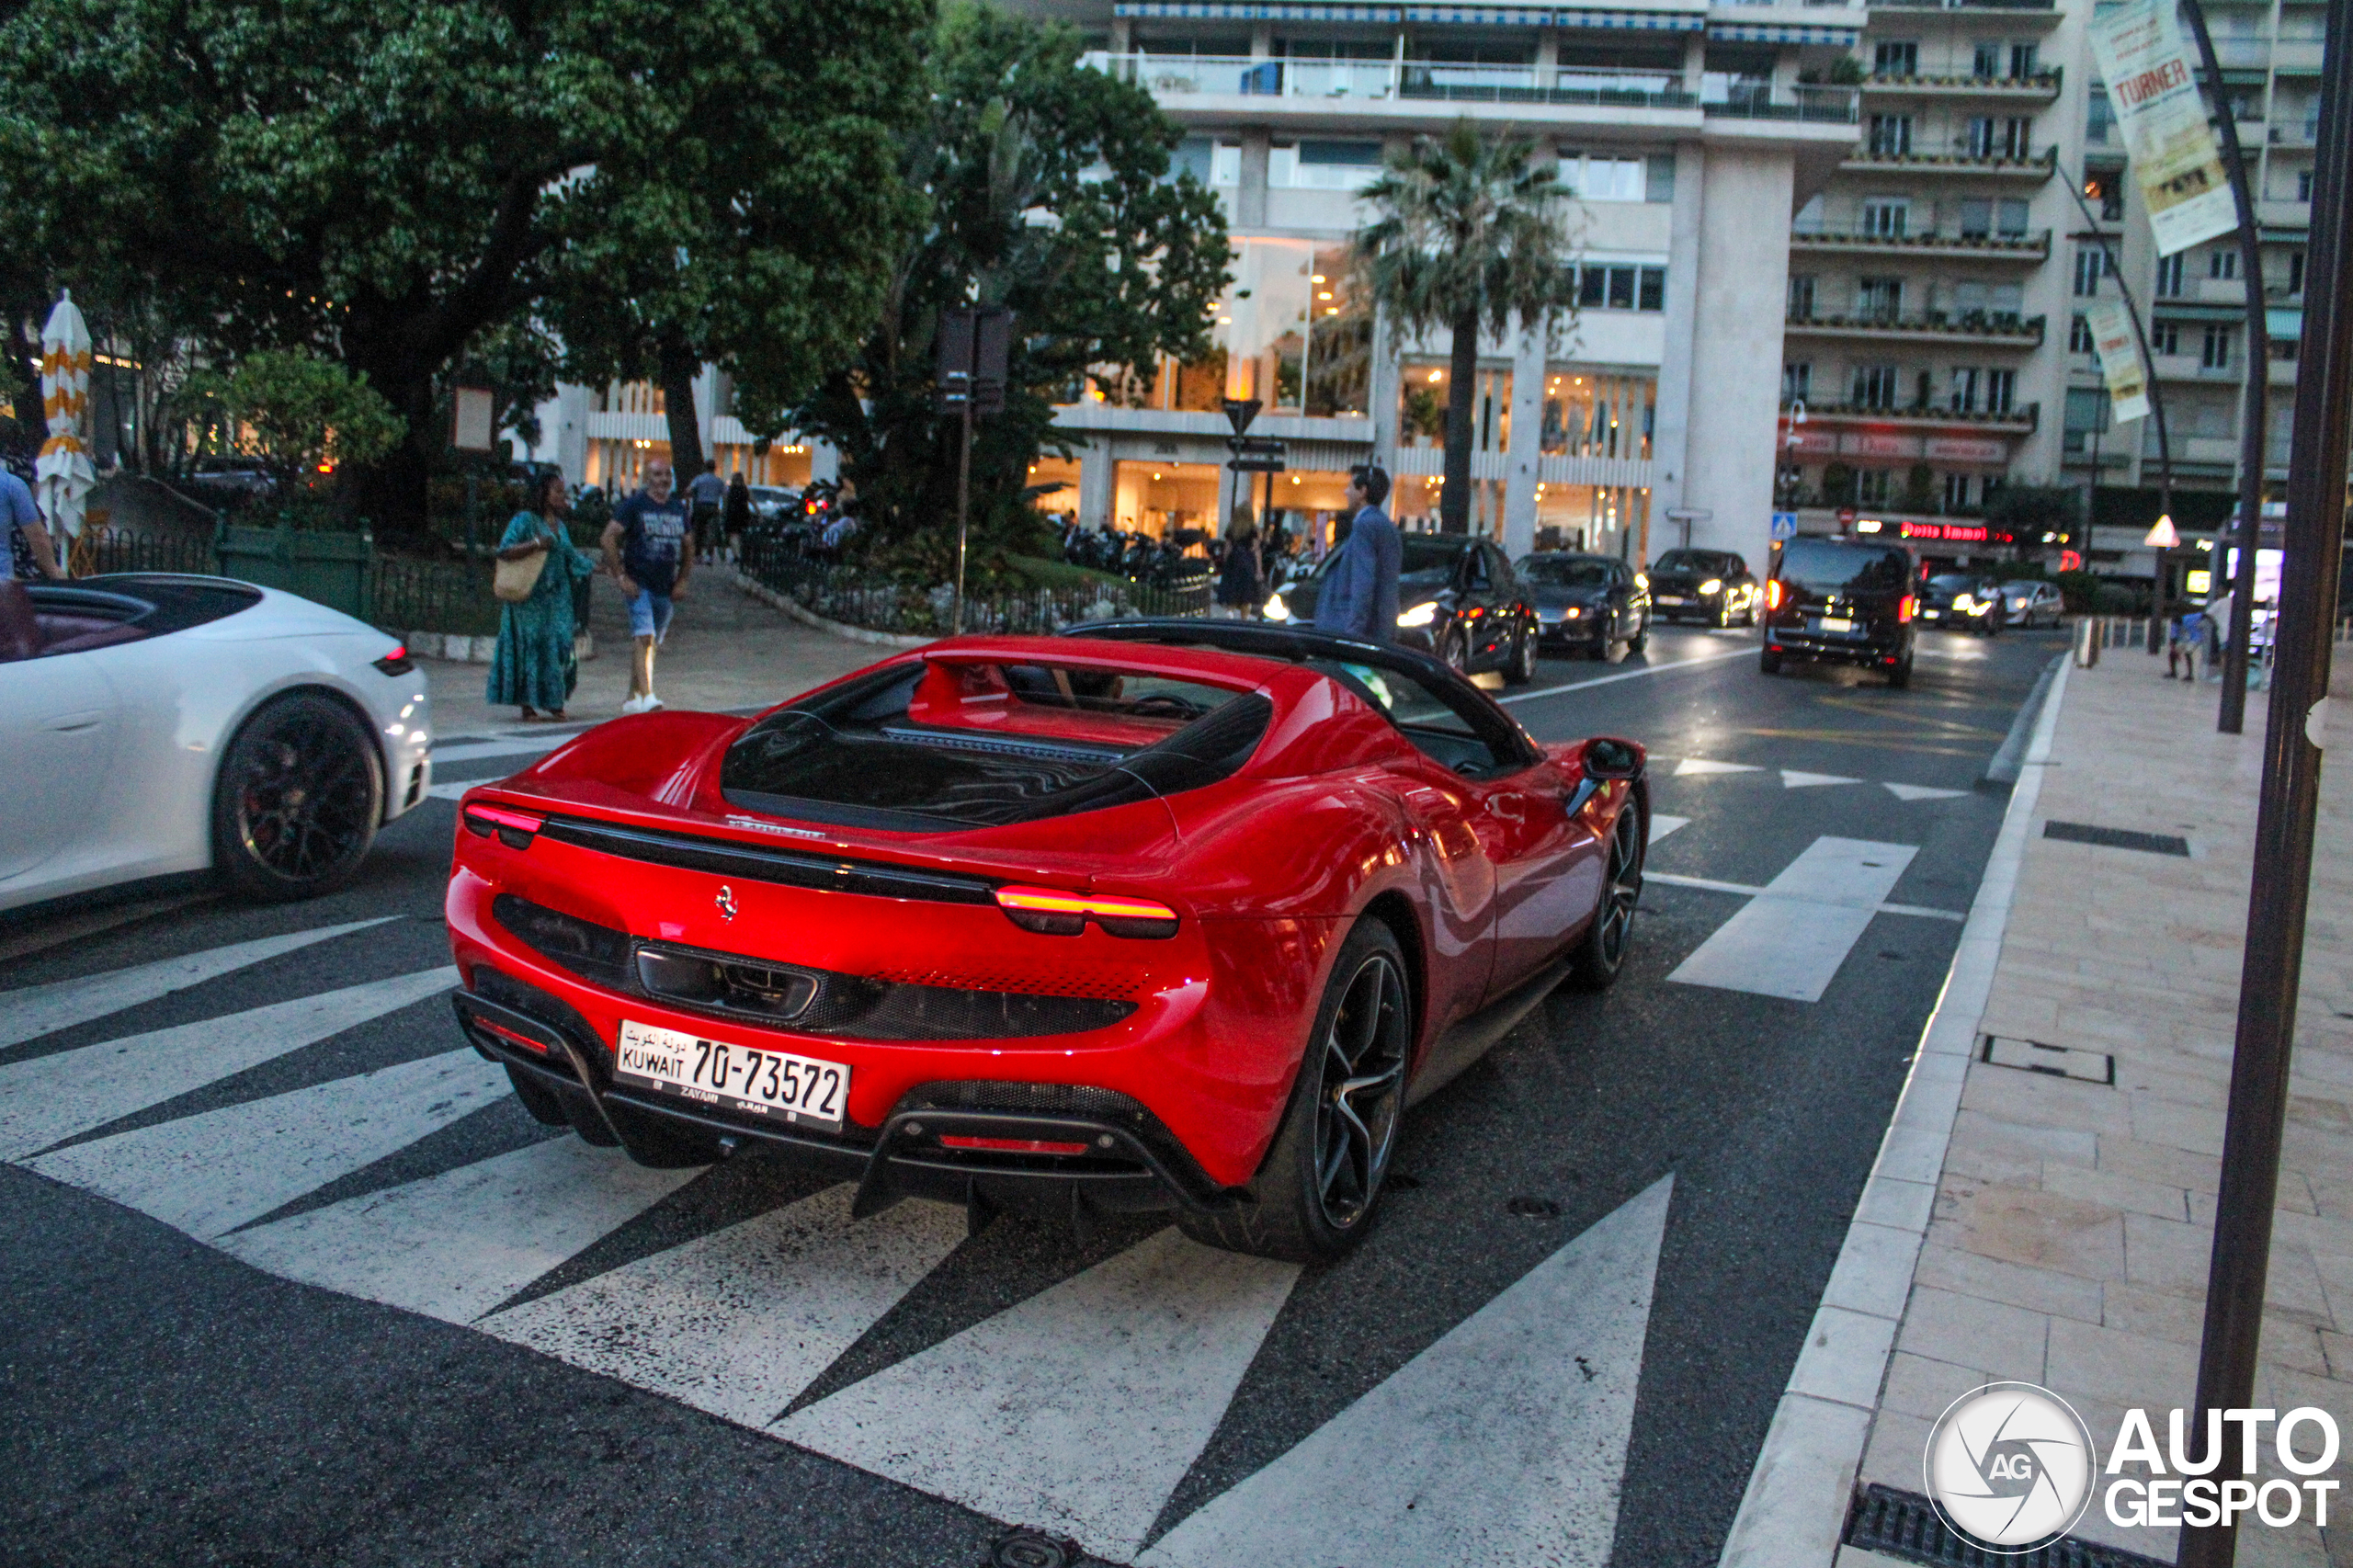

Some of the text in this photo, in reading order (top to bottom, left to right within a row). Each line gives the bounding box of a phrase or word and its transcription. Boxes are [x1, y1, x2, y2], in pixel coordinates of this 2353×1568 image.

[2115, 58, 2188, 108] TURNER
[626, 1029, 687, 1054] دولة الكويت
[623, 1047, 684, 1078] KUWAIT
[693, 1040, 840, 1115] 70-73572
[680, 1086, 719, 1104] ZAYANI
